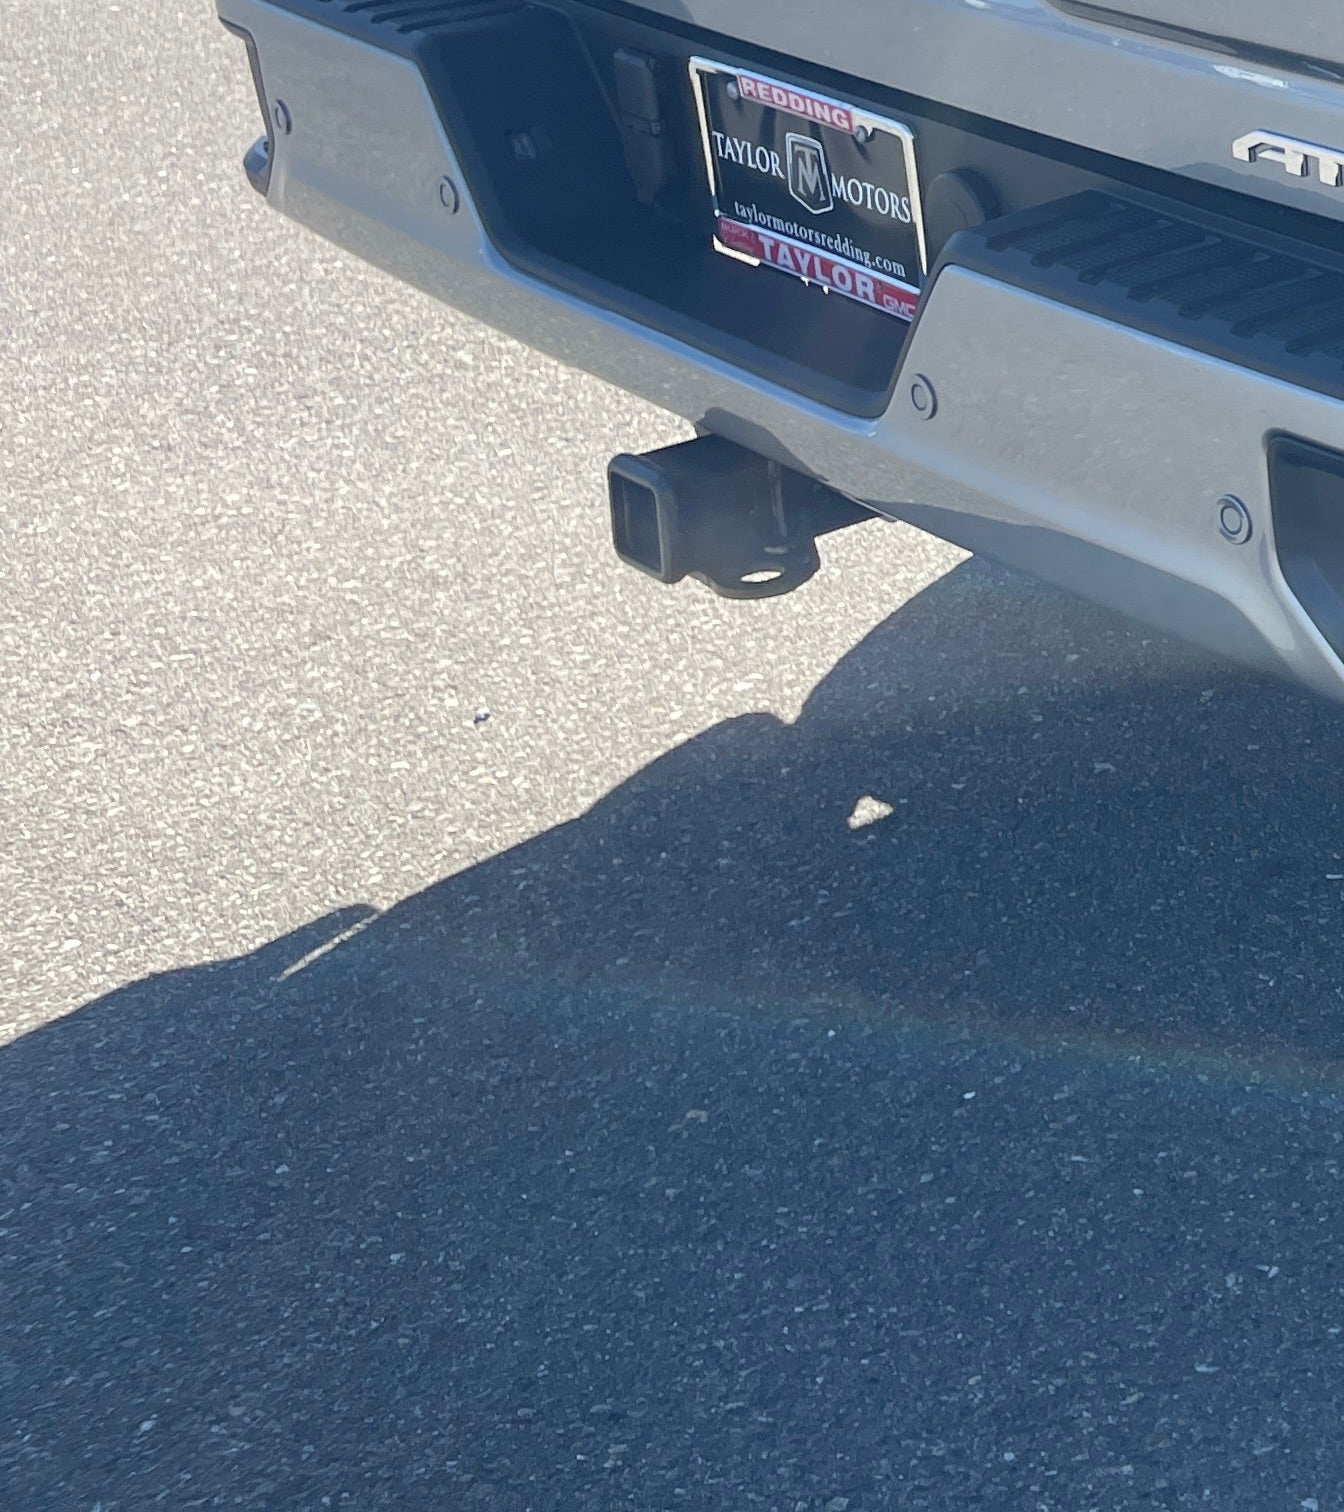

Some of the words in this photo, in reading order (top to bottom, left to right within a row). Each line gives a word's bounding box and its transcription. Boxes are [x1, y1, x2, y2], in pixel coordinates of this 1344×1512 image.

[740, 77, 850, 129] REDDING
[712, 131, 785, 179] TAYLOR
[831, 172, 911, 224] MOTORS
[734, 200, 906, 278] taylormotorsredding.com
[757, 233, 876, 304] TAYLOR
[883, 293, 916, 318] GMC
